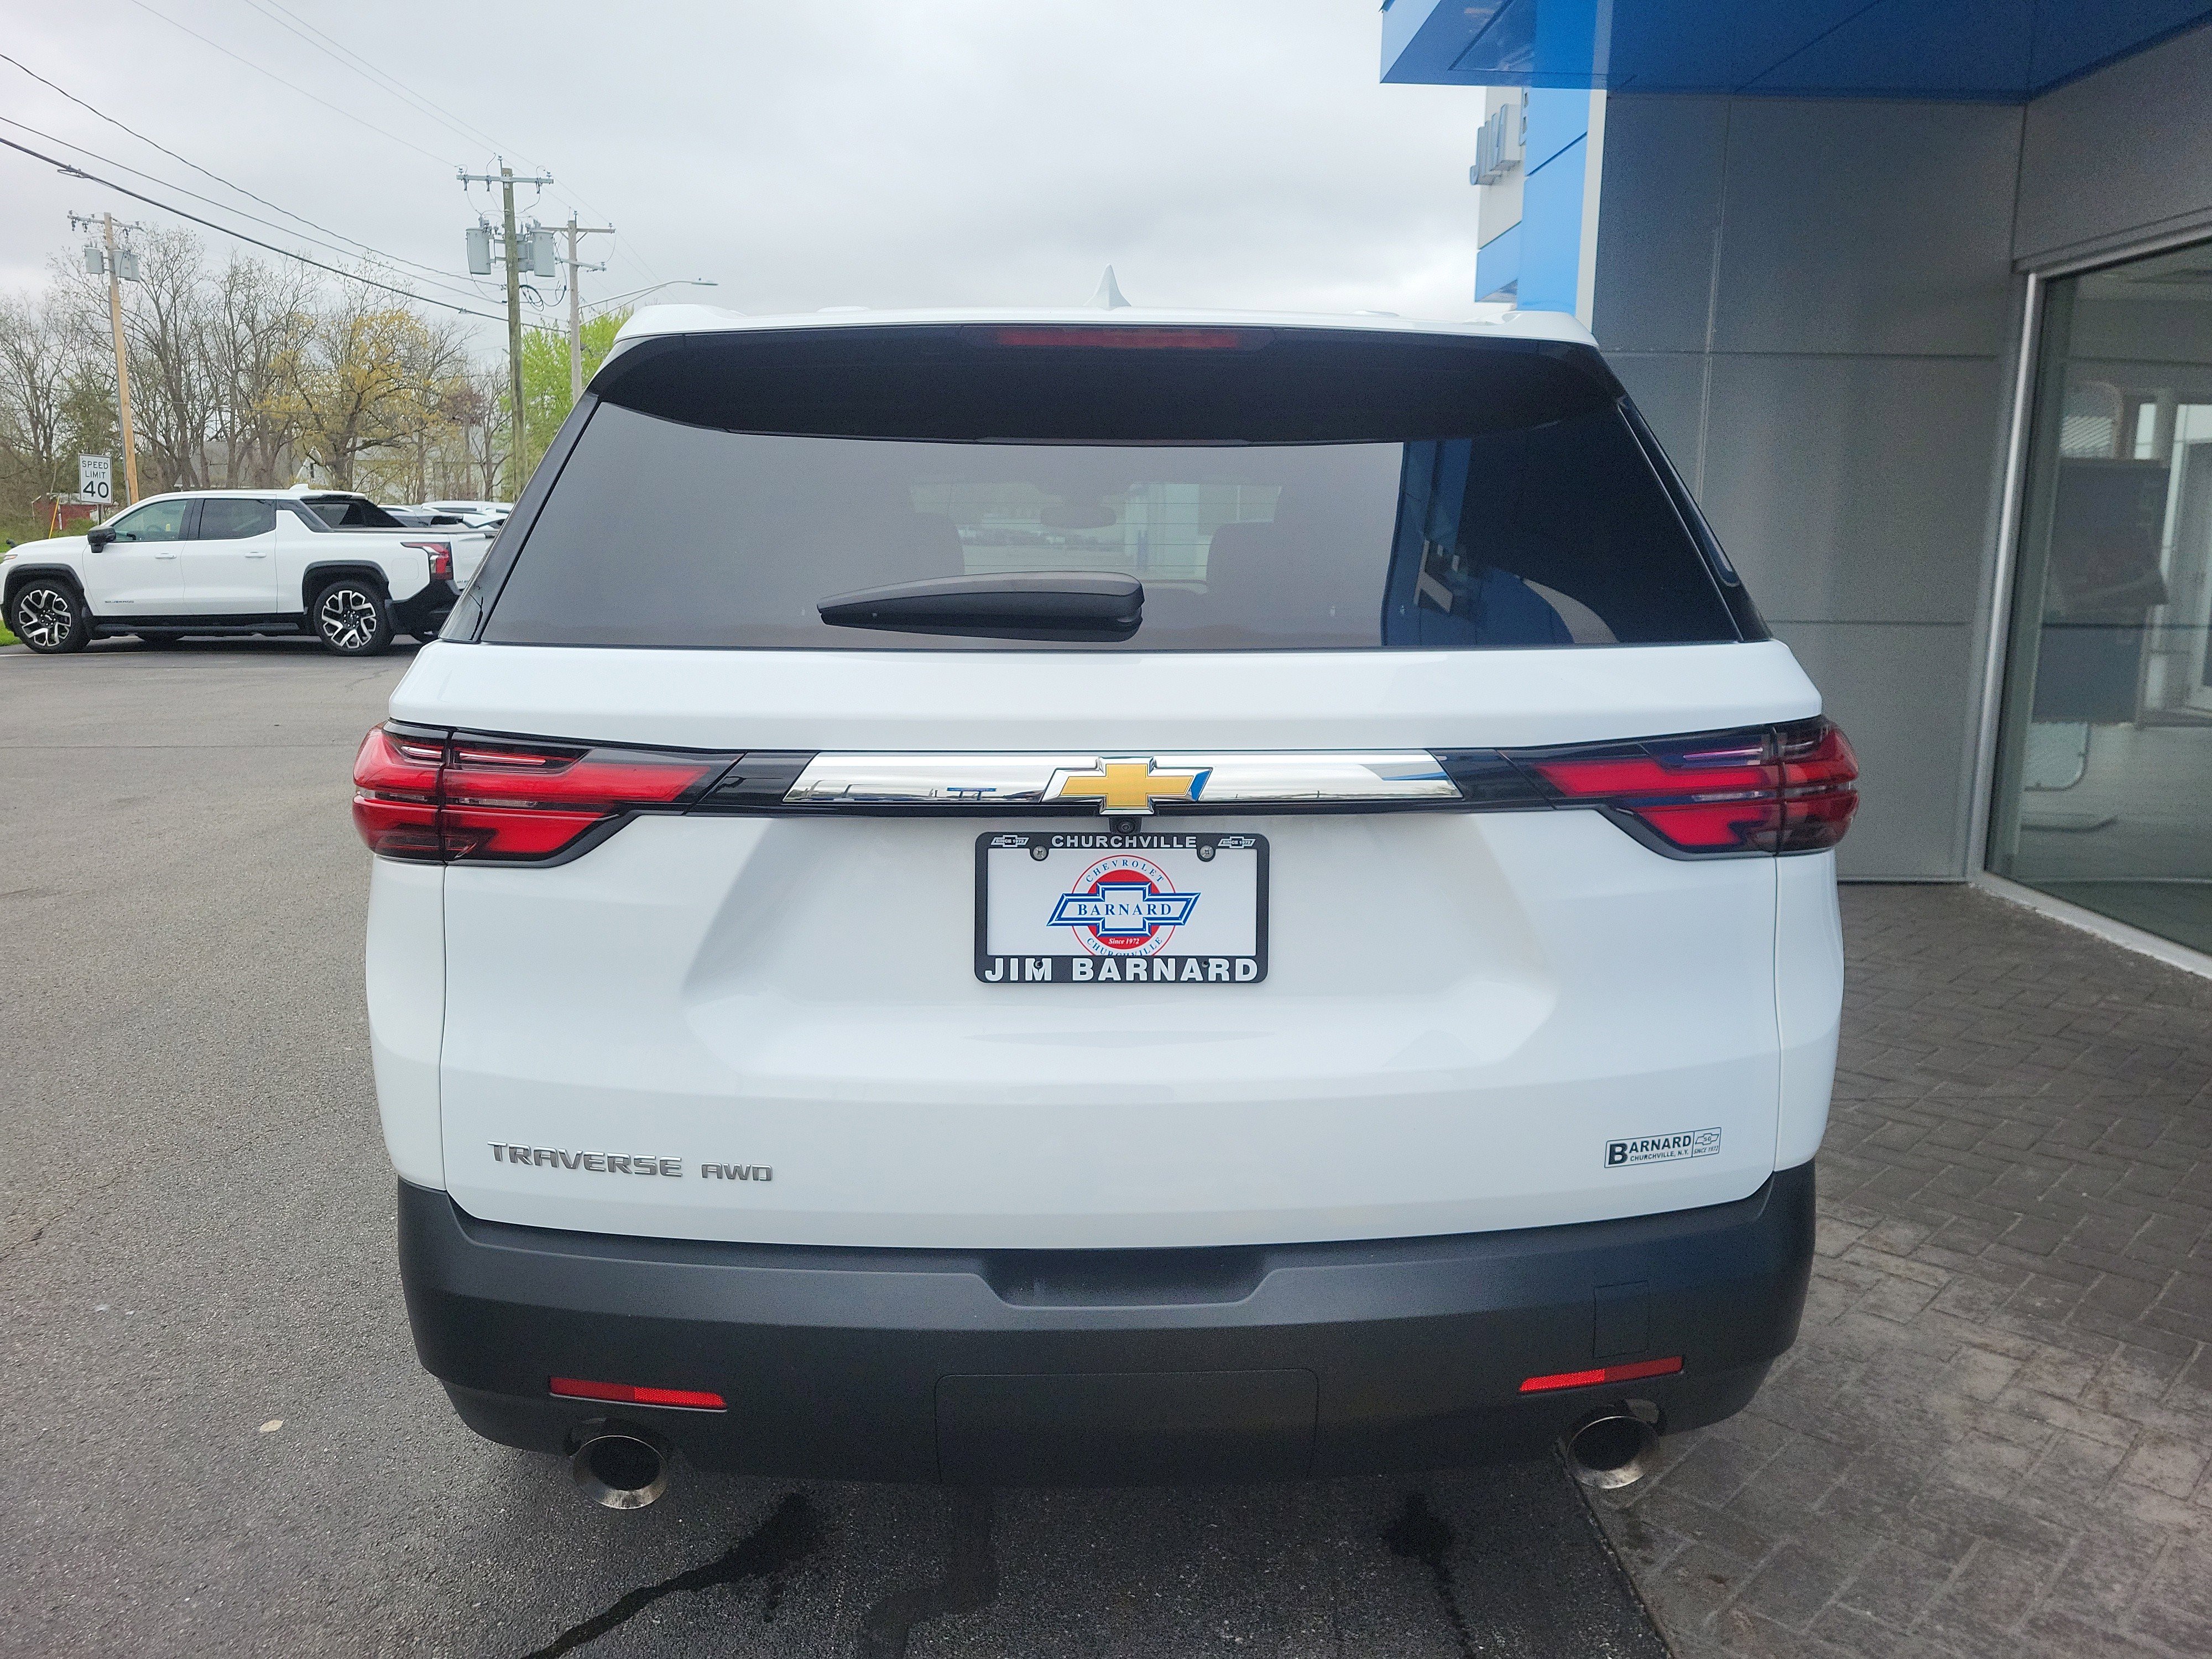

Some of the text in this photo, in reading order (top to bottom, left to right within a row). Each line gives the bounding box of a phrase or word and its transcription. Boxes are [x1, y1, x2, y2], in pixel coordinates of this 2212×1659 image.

[82, 460, 109, 469] SPEED
[85, 470, 106, 479] LIMIT
[83, 481, 109, 498] 40
[1051, 835, 1197, 848] CHURCHVILLE
[1086, 859, 1164, 883] CHEVROLET
[1077, 903, 1172, 916] BARNARD
[985, 957, 1258, 982] JIM BARNARD
[1608, 1135, 1692, 1165] BARNARD
[1630, 1151, 1676, 1162] CHURCHVILLE,
[487, 1140, 773, 1182] TRAVERSE AWD
